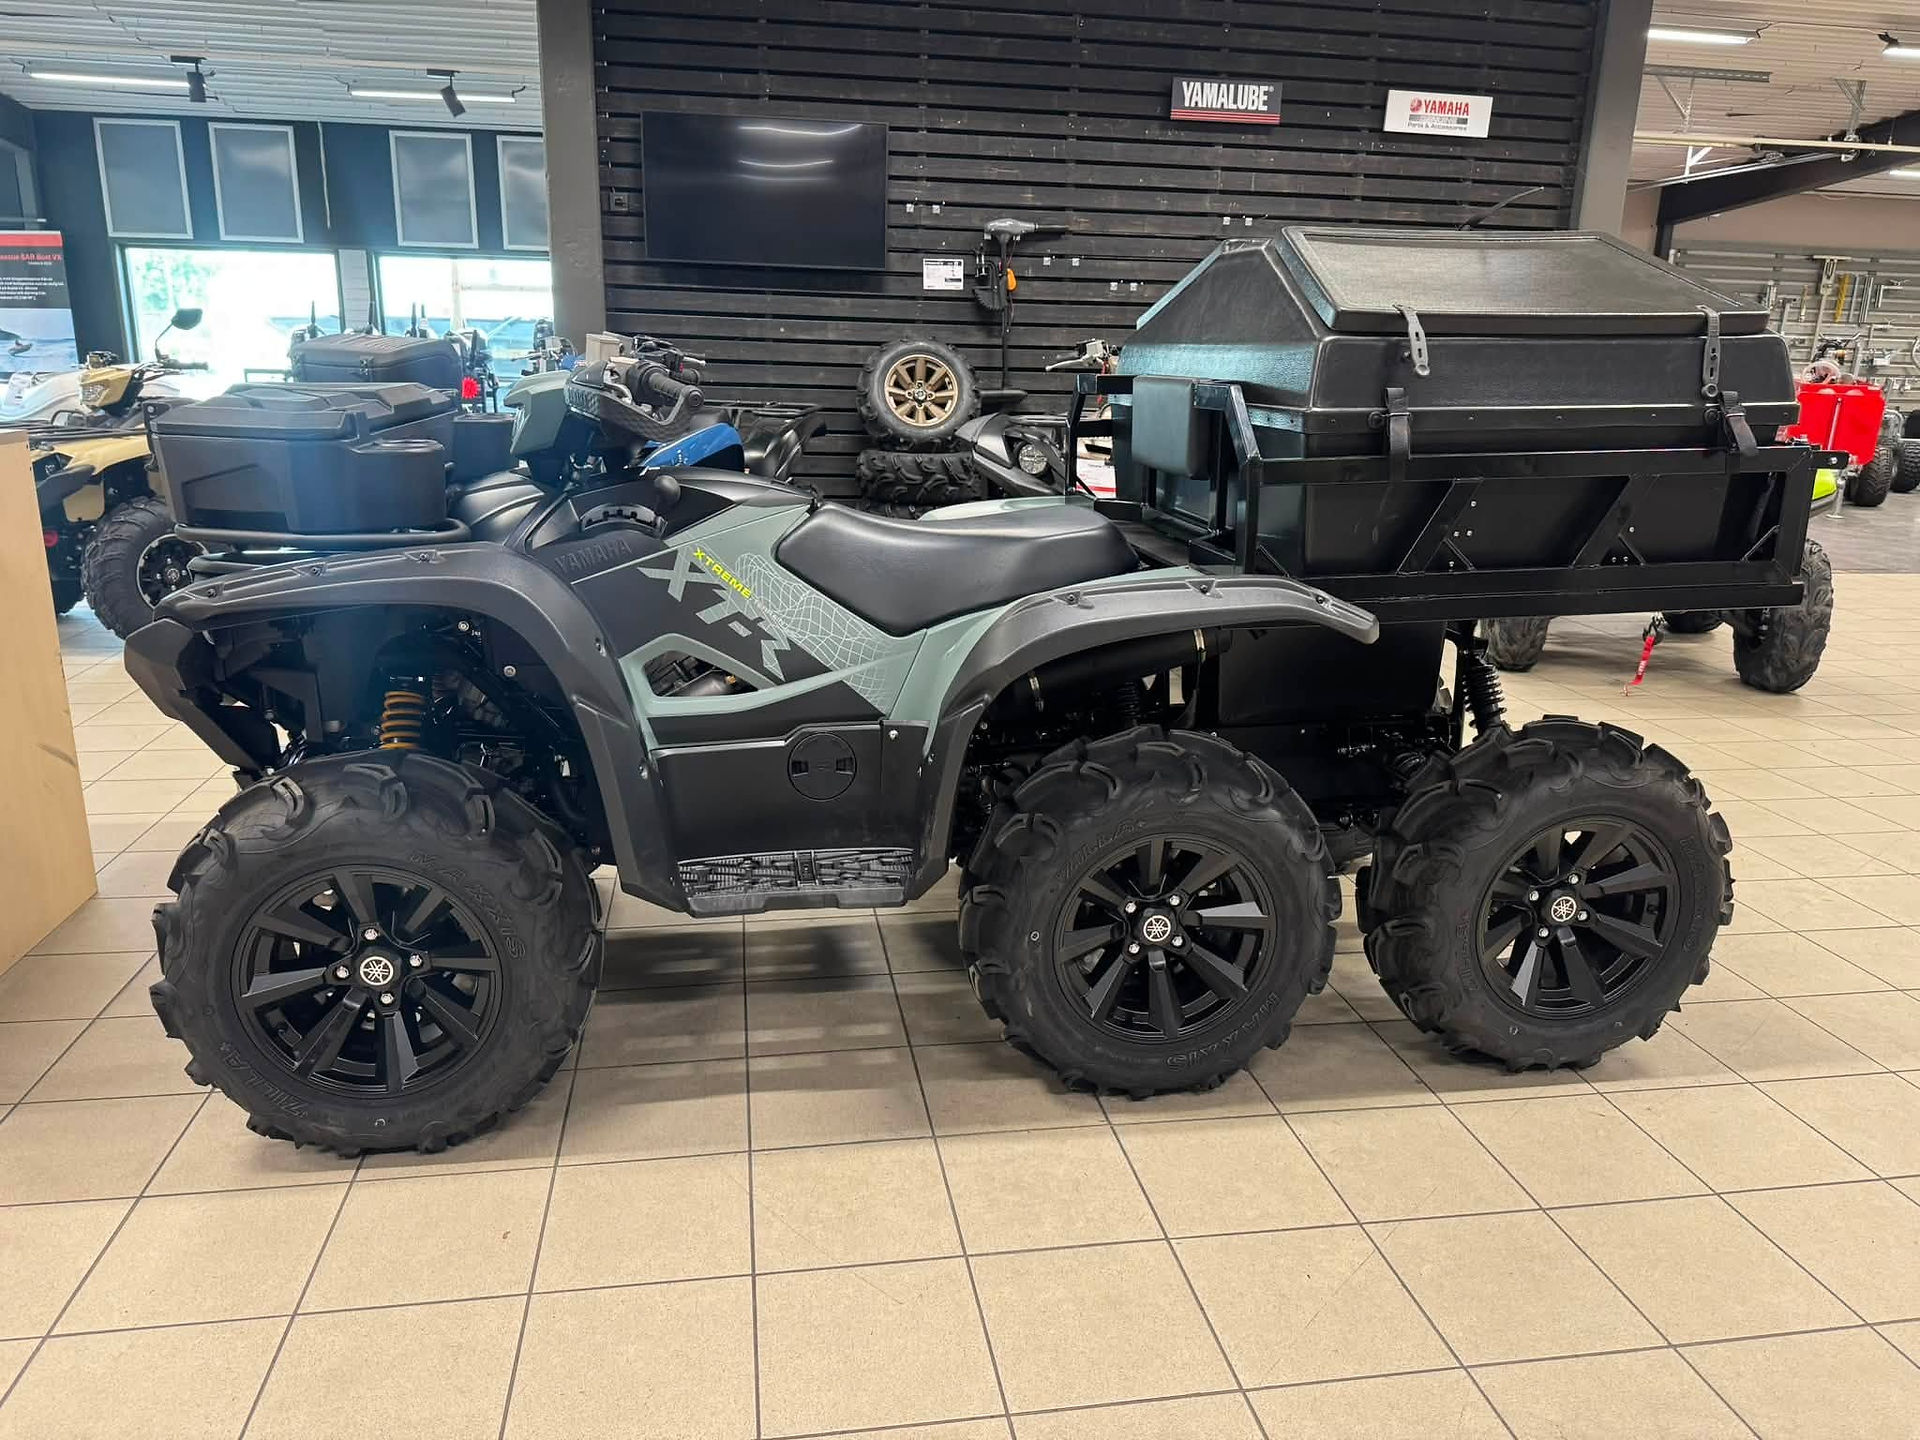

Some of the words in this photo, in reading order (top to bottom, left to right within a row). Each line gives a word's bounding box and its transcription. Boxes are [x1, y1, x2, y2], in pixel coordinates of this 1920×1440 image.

[1182, 81, 1269, 111] YAMALUBE
[1423, 99, 1470, 116] YAMAHA
[553, 537, 633, 575] YAMAHA
[692, 546, 752, 600] XTREME
